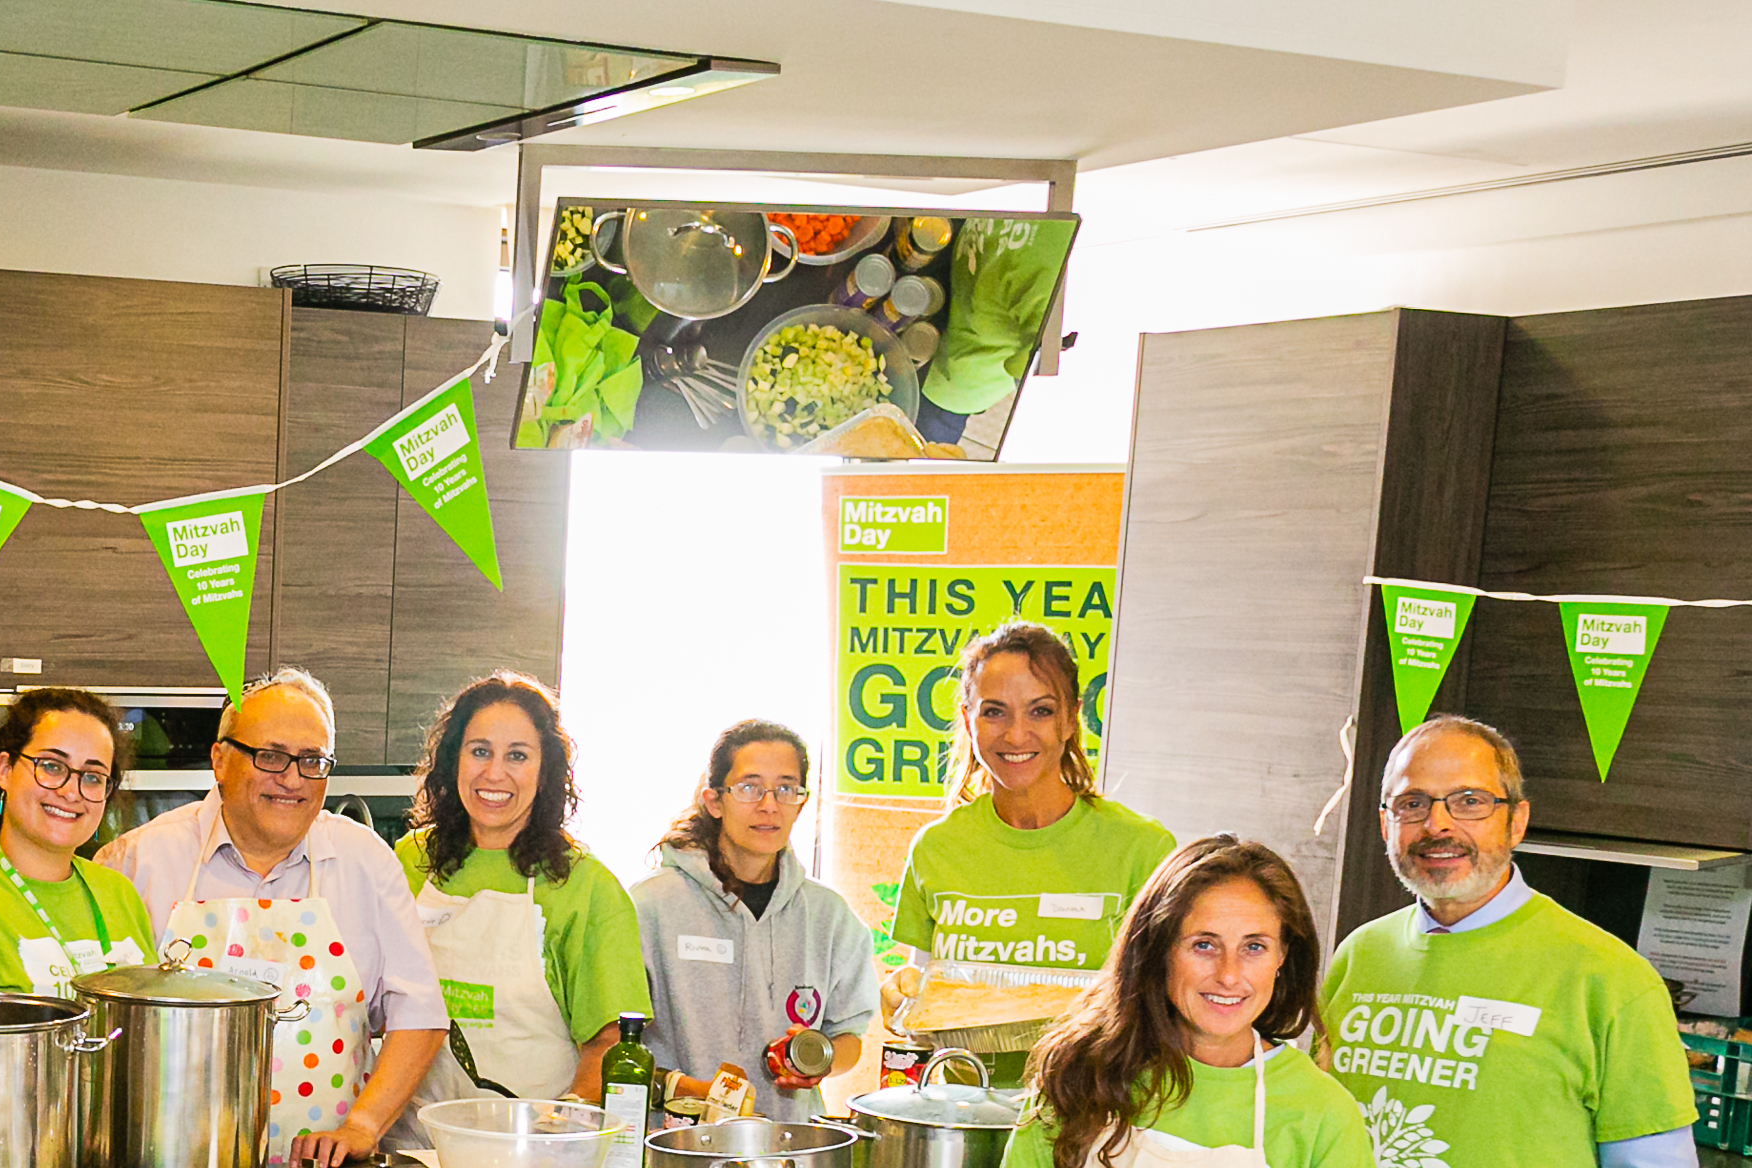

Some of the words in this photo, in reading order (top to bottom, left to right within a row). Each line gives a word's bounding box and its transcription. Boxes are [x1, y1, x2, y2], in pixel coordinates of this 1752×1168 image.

[399, 412, 458, 457] Mitzvah
[405, 446, 435, 472] Day
[422, 453, 467, 487] Celebrating
[433, 482, 445, 494] 10
[443, 468, 467, 487] Years
[433, 498, 443, 510] of
[442, 476, 478, 503] Mitzvahs
[843, 500, 943, 523] Mitzvah
[172, 518, 241, 542] Mitzvah
[842, 523, 891, 550] Day
[175, 543, 208, 559] Day
[187, 563, 240, 580] Celebrating
[196, 581, 208, 591] 10
[209, 578, 235, 589] Years
[191, 595, 201, 606] of
[203, 589, 243, 604] Mitzvahs
[849, 577, 977, 616] THIS
[1002, 579, 1114, 619] YEA
[1400, 601, 1452, 619] Mitzvah
[1398, 615, 1424, 631] Day
[1581, 618, 1642, 634] Mitzvah
[849, 626, 980, 655] MITZV
[1580, 633, 1609, 650] Day
[1584, 656, 1634, 668] Celebrating
[1590, 667, 1601, 676] 10
[1602, 668, 1626, 678] Years
[1583, 678, 1593, 686] of
[1593, 678, 1633, 689] Mitzvahs
[937, 899, 1018, 928] More
[934, 932, 1087, 966] Mitzvahs,
[228, 966, 258, 979] Arnold
[442, 985, 489, 1002] Mitzvah
[1352, 992, 1374, 1003] THIS
[1376, 993, 1401, 1004] YEAR
[1403, 993, 1456, 1011] MITZVAH
[1339, 1004, 1493, 1058] GOING
[1333, 1046, 1479, 1091] GREENER
